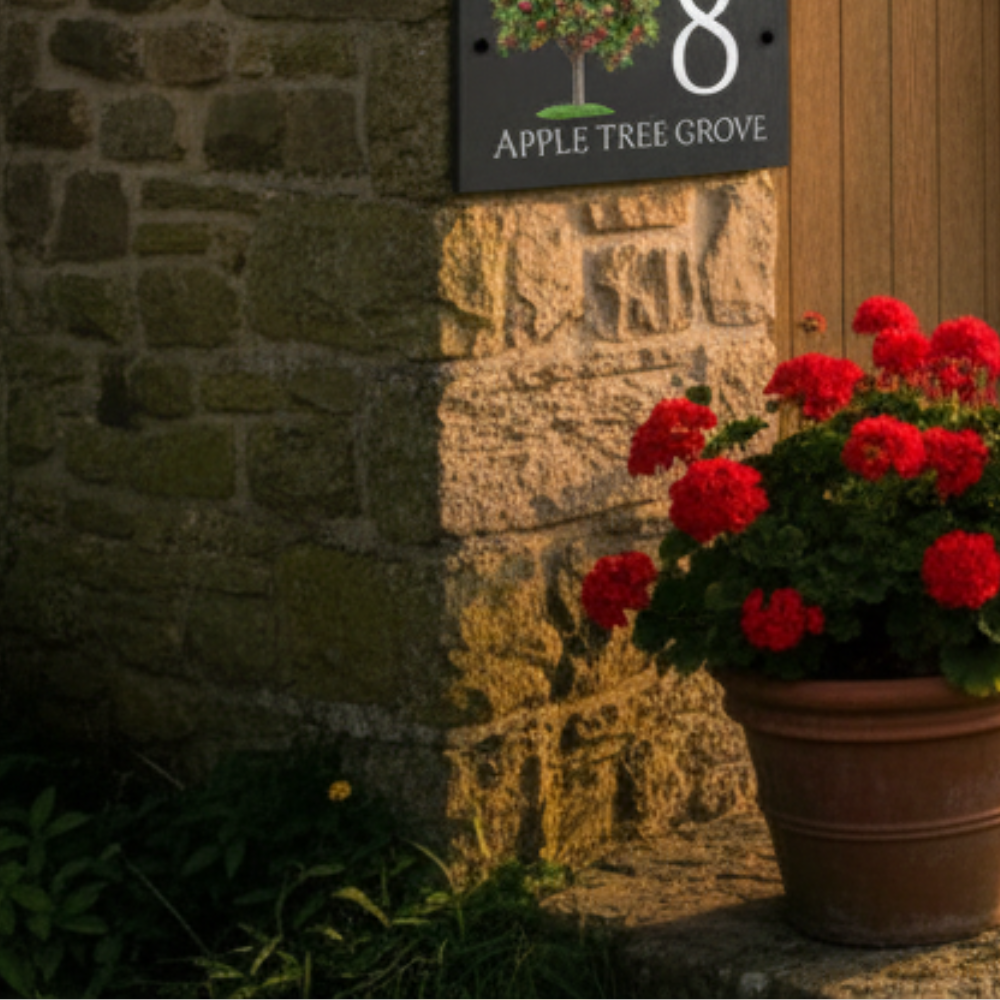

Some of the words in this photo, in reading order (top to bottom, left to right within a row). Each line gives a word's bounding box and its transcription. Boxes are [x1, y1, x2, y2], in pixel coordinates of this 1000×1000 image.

[493, 126, 588, 159] APPLE
[596, 120, 668, 151] TREE
[675, 115, 767, 145] GROVE
